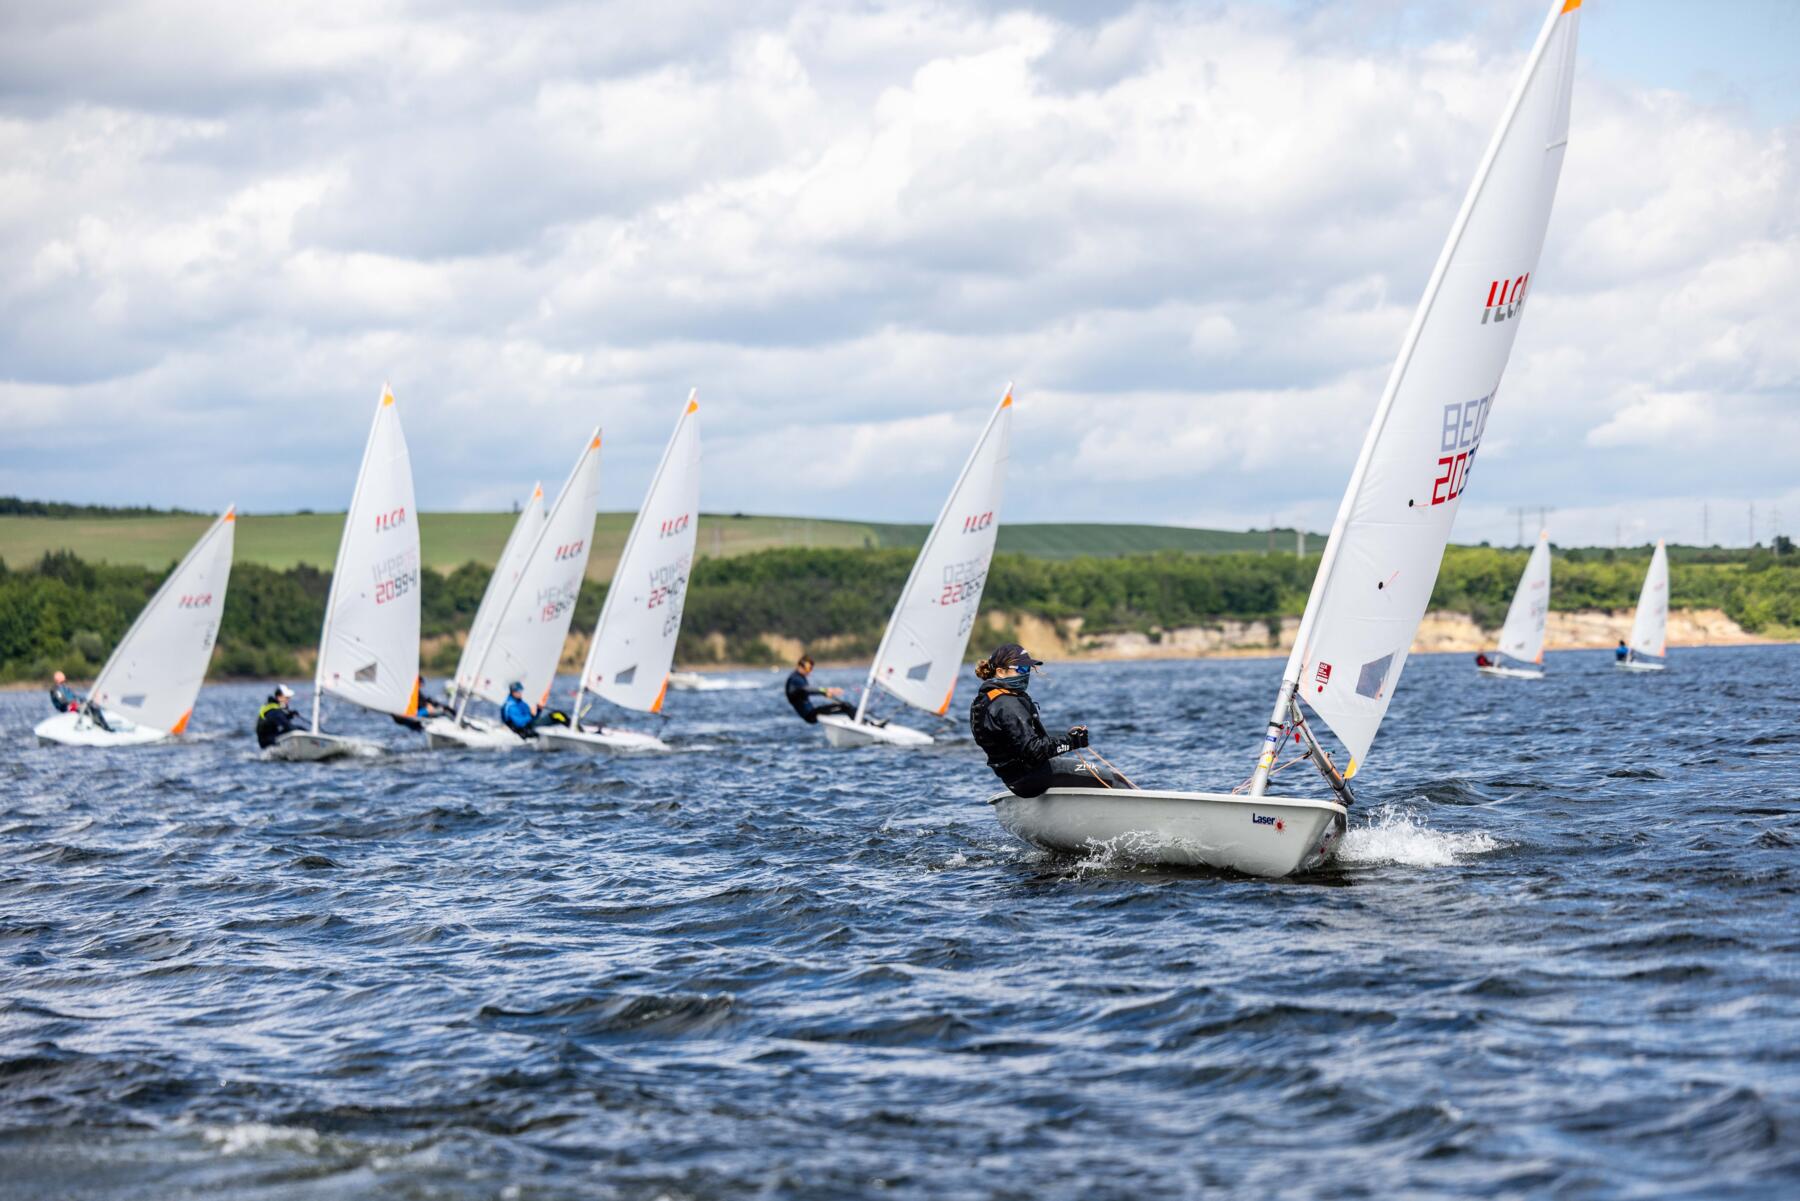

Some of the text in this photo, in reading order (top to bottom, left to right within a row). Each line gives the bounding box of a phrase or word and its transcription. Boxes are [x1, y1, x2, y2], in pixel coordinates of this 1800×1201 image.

[1480, 272, 1529, 325] ILCA
[376, 506, 406, 533] ILCA
[660, 513, 689, 539] ILCA
[963, 511, 993, 535] ILCA
[1252, 812, 1276, 825] Laser
